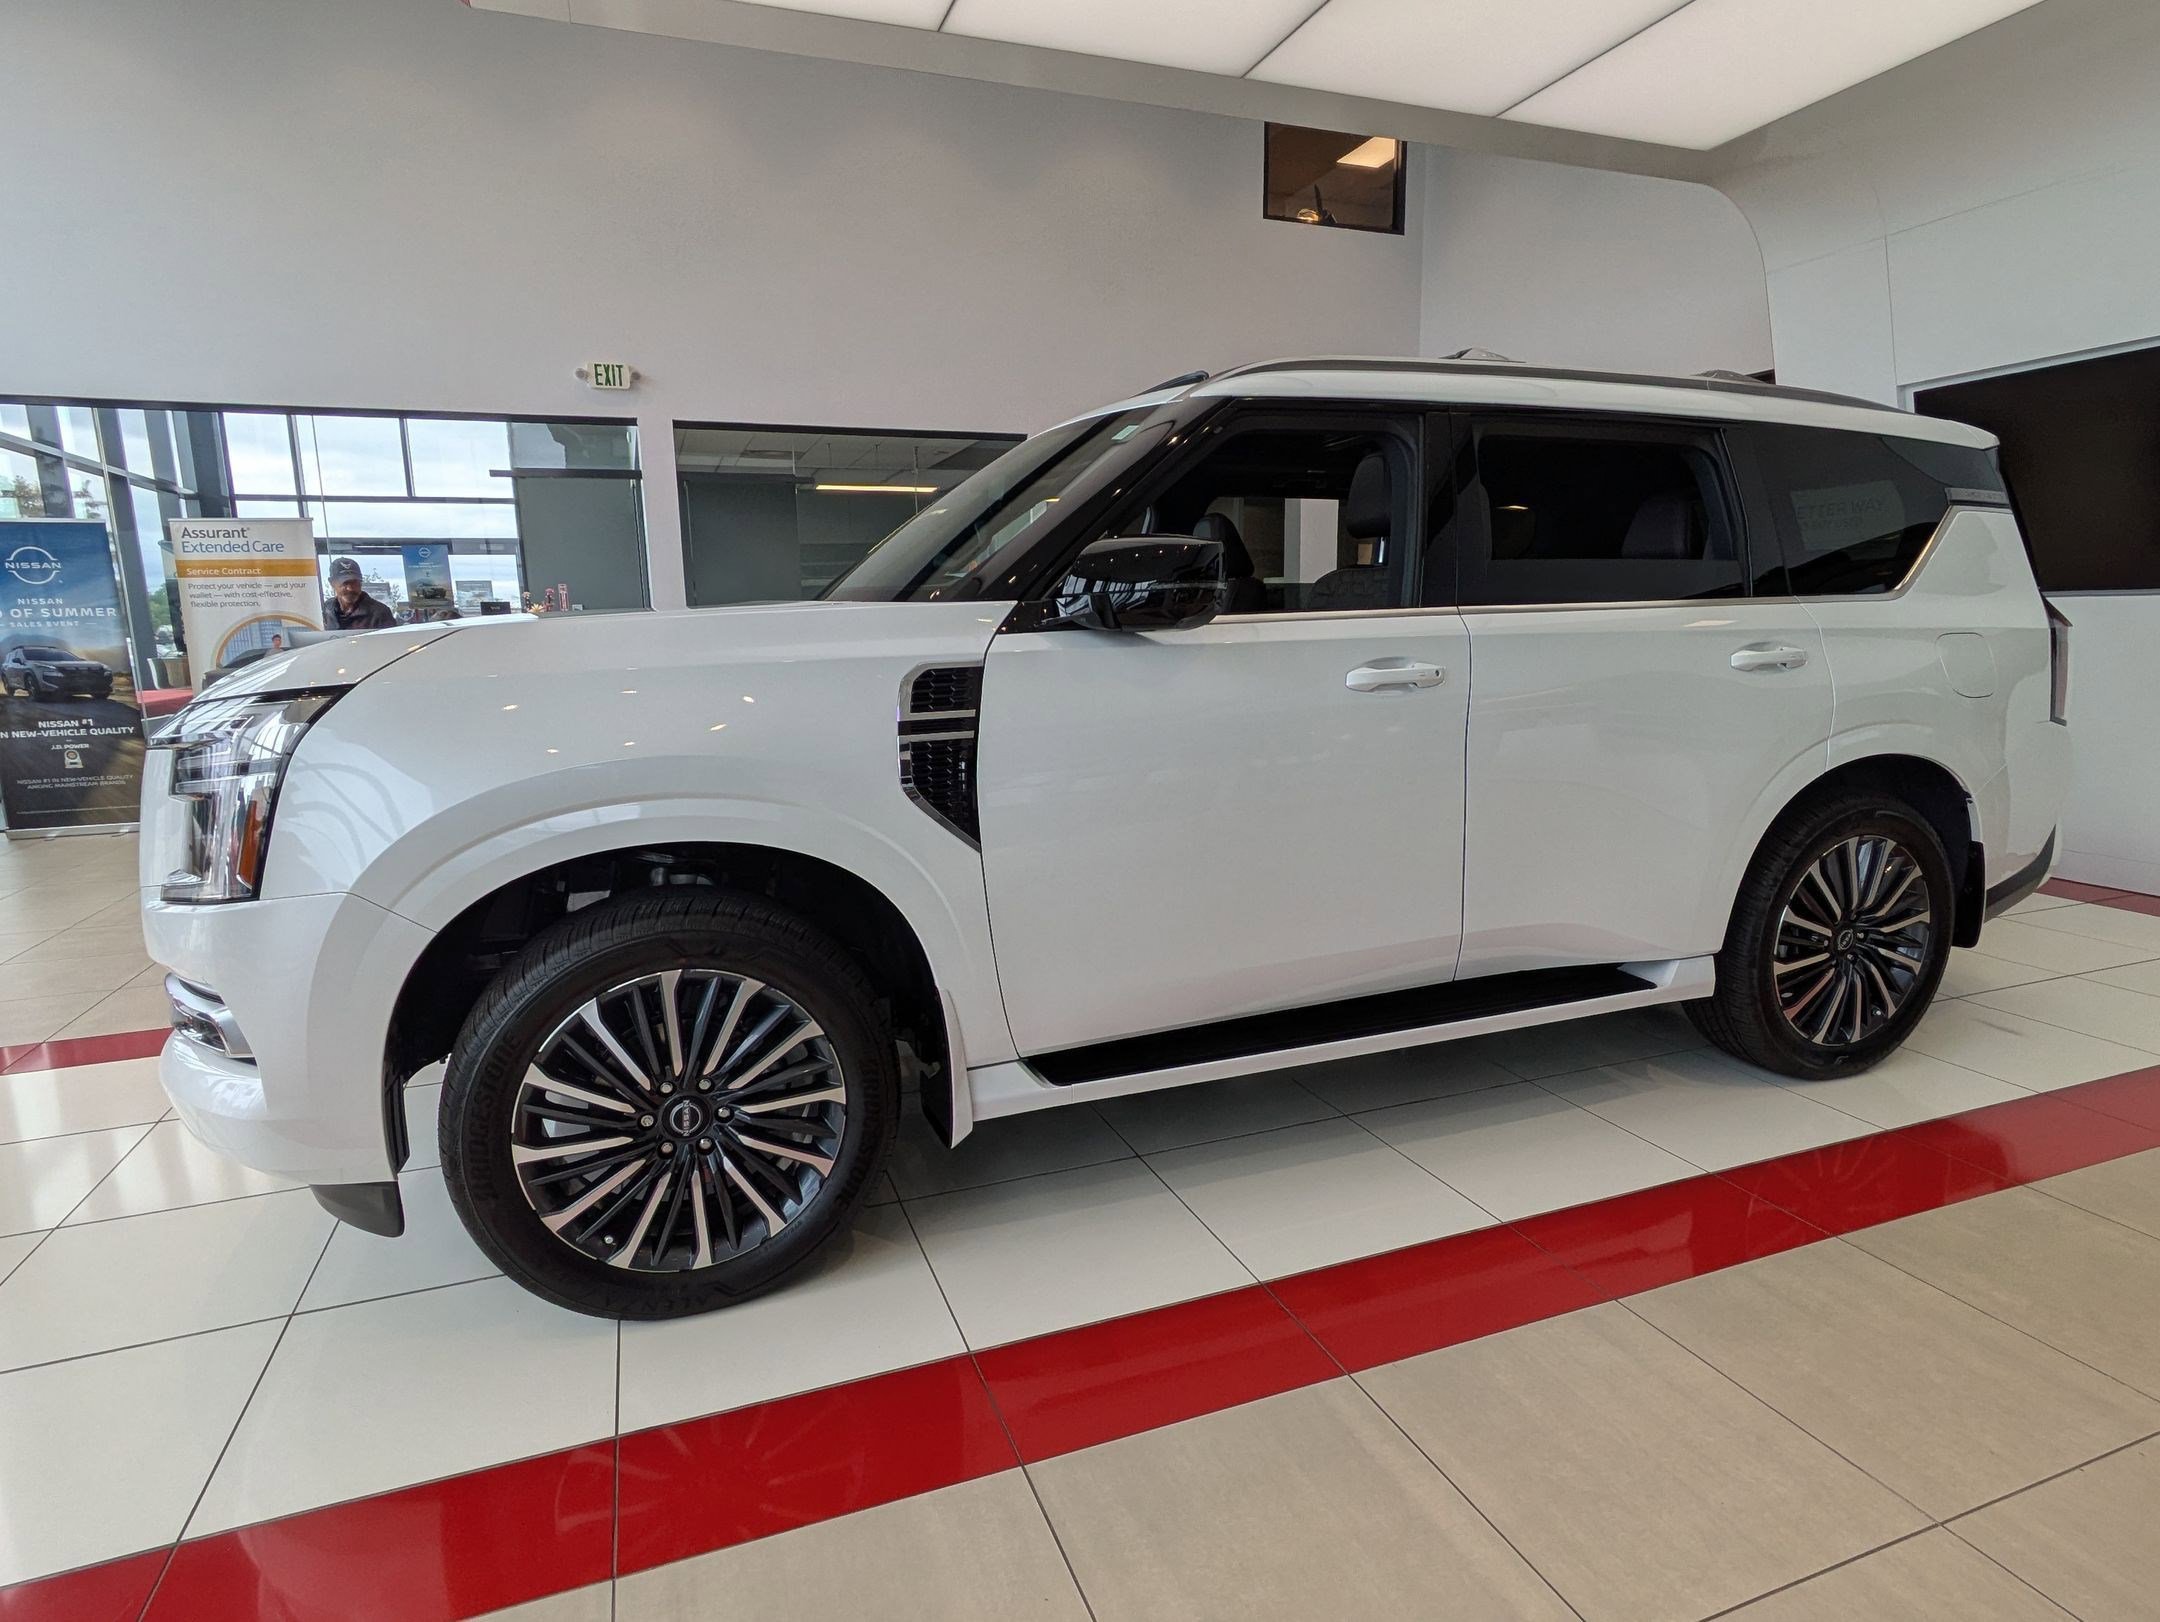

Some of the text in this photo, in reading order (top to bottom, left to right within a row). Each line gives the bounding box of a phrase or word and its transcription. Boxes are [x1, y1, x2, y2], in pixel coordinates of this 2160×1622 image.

[594, 363, 624, 387] EXIT
[181, 527, 248, 539] Assurant
[182, 541, 284, 553] Extended Care
[186, 567, 262, 576] Service Contract
[290, 582, 307, 590] your
[10, 607, 33, 618] OF
[41, 607, 117, 618] SUMMER
[38, 718, 94, 729] NISSAN #1
[0, 726, 135, 739] N NEW-VEHICLE QUALITY
[682, 1100, 690, 1137] NISSAN
